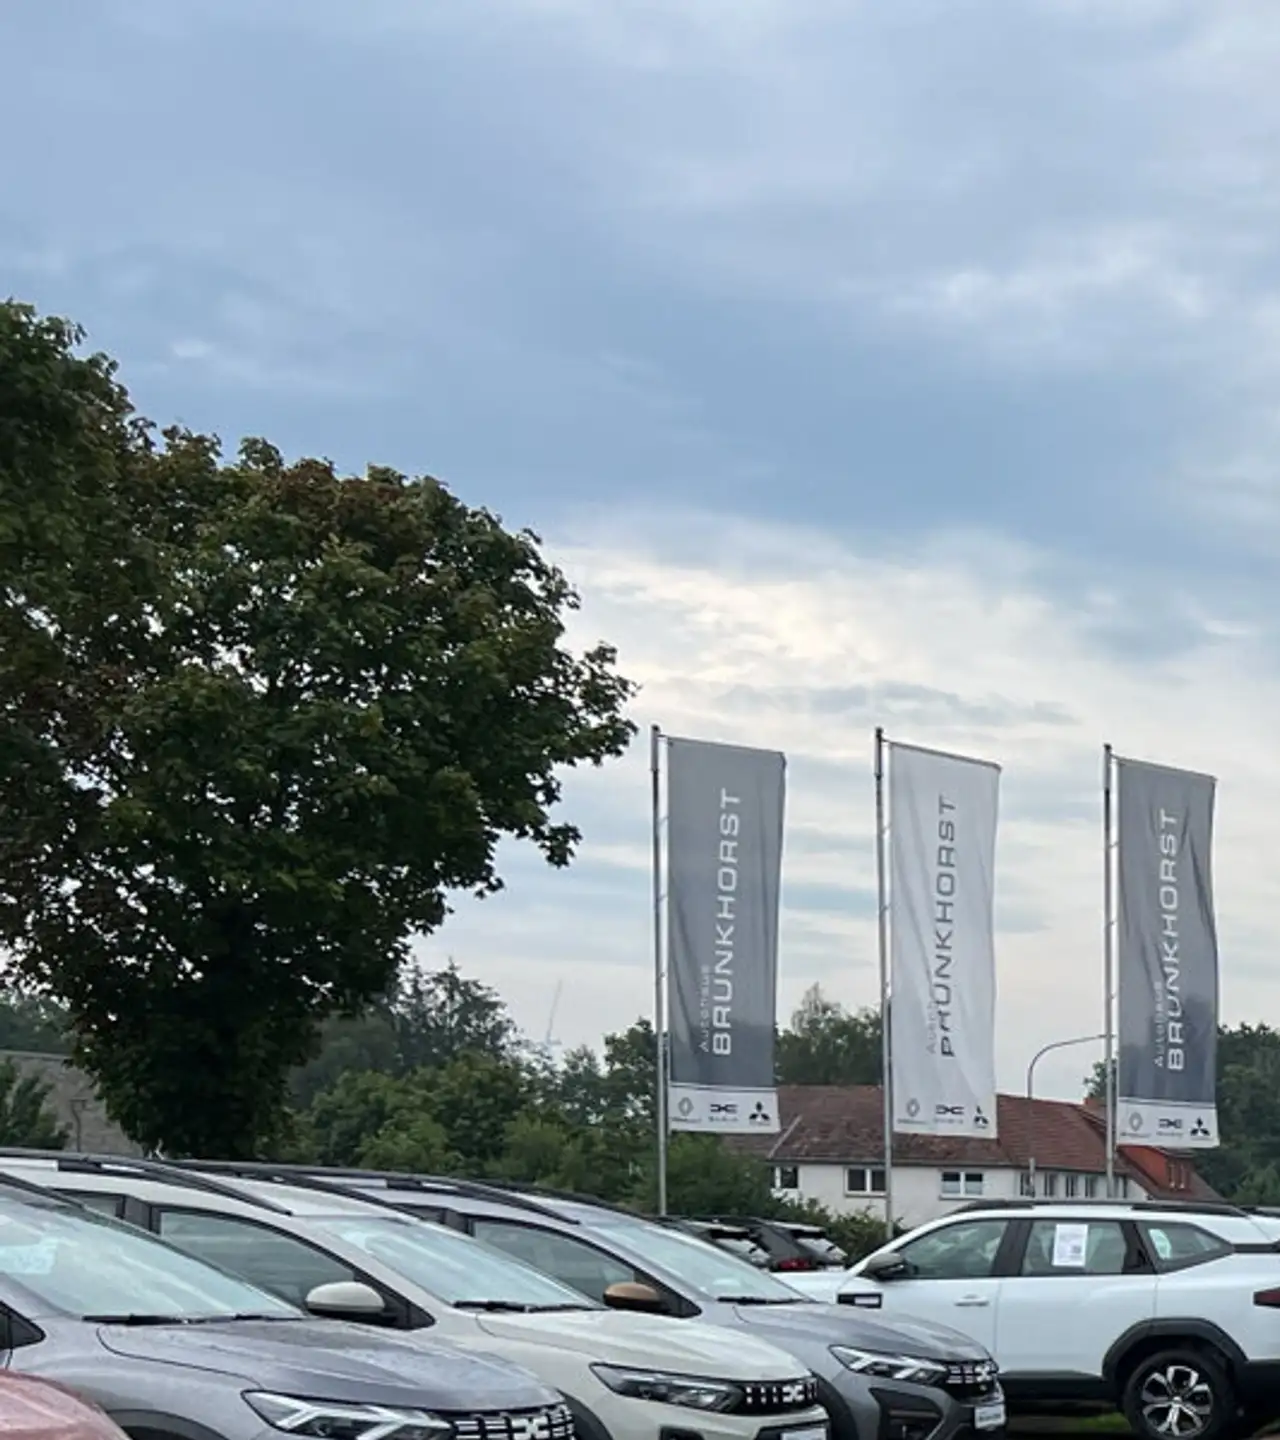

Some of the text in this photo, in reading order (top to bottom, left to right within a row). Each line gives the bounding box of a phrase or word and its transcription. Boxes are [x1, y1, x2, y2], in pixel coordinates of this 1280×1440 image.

[700, 965, 712, 1052] Autohaus
[713, 788, 741, 1056] BRUNKHORST
[1158, 808, 1186, 1072] BRUNKHORST
